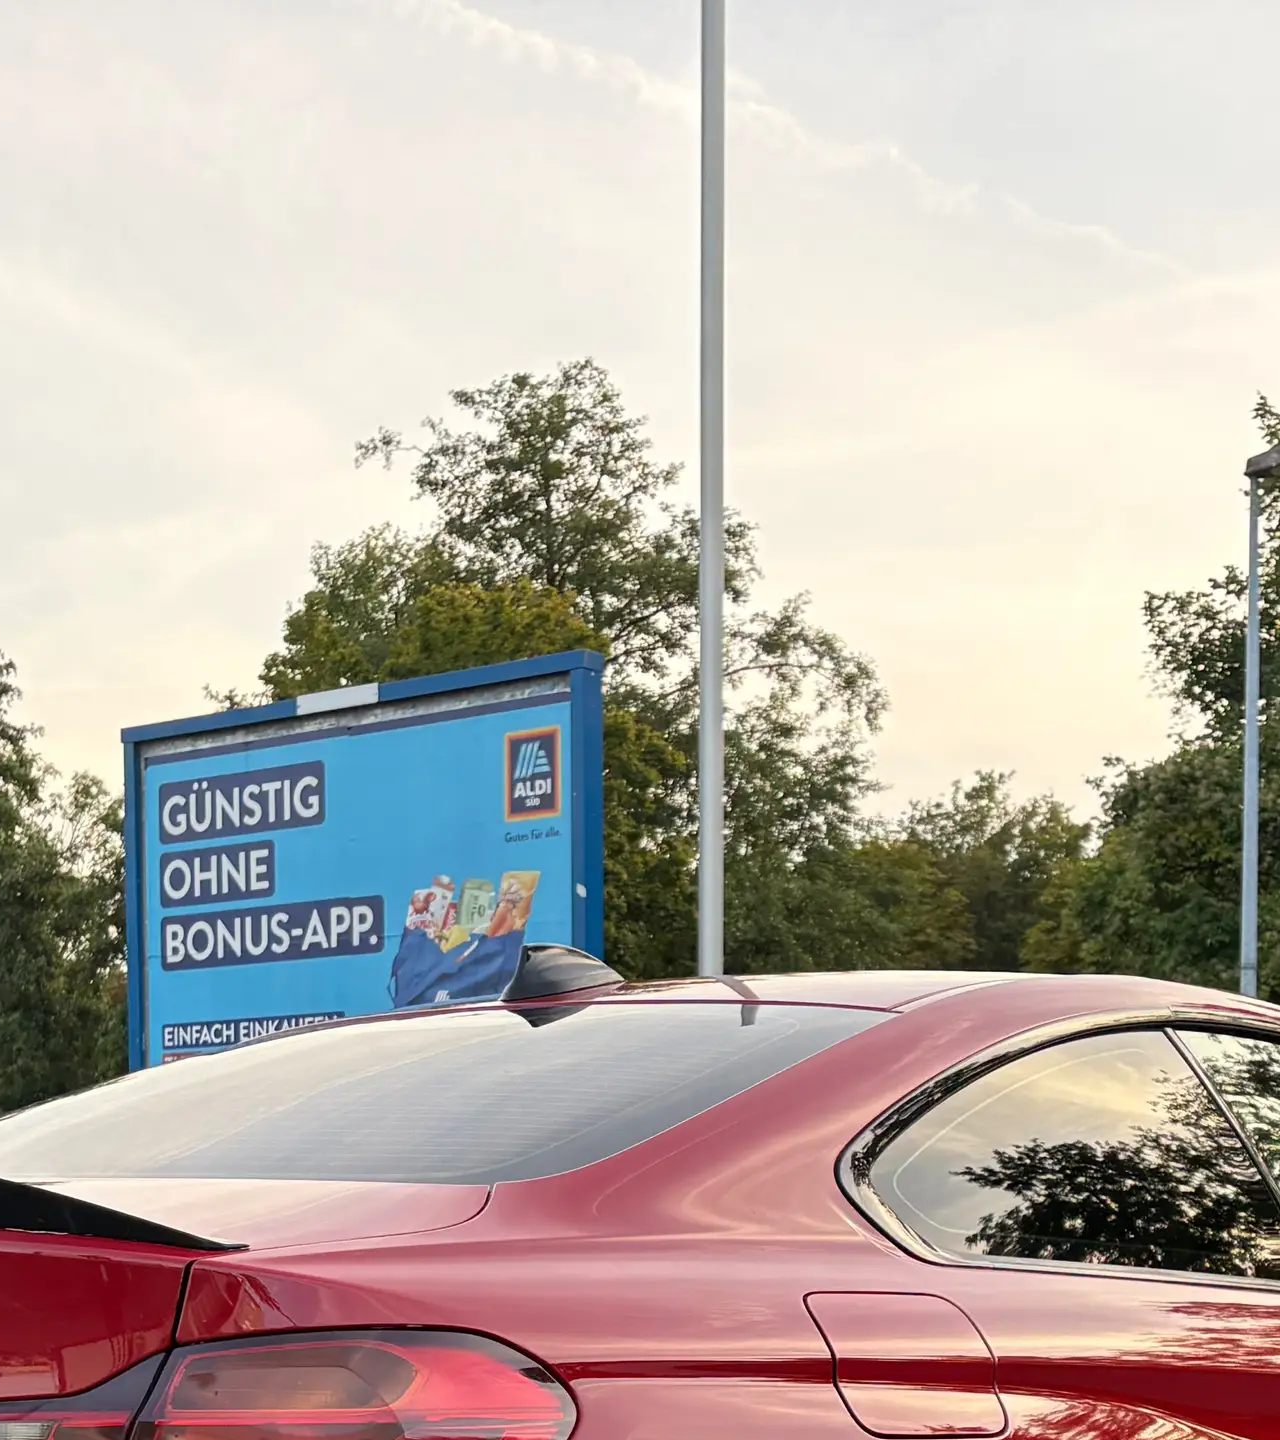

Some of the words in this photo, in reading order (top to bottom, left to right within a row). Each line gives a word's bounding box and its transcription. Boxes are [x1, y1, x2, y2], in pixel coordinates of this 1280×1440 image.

[162, 775, 320, 836] GÜNSTIG
[514, 778, 552, 798] ALDI
[525, 796, 541, 807] SÜD
[163, 848, 270, 900] OHNE
[165, 905, 379, 964] BONUS-APP.
[163, 1022, 235, 1047] EINFACH
[239, 1015, 338, 1042] EINKAU
